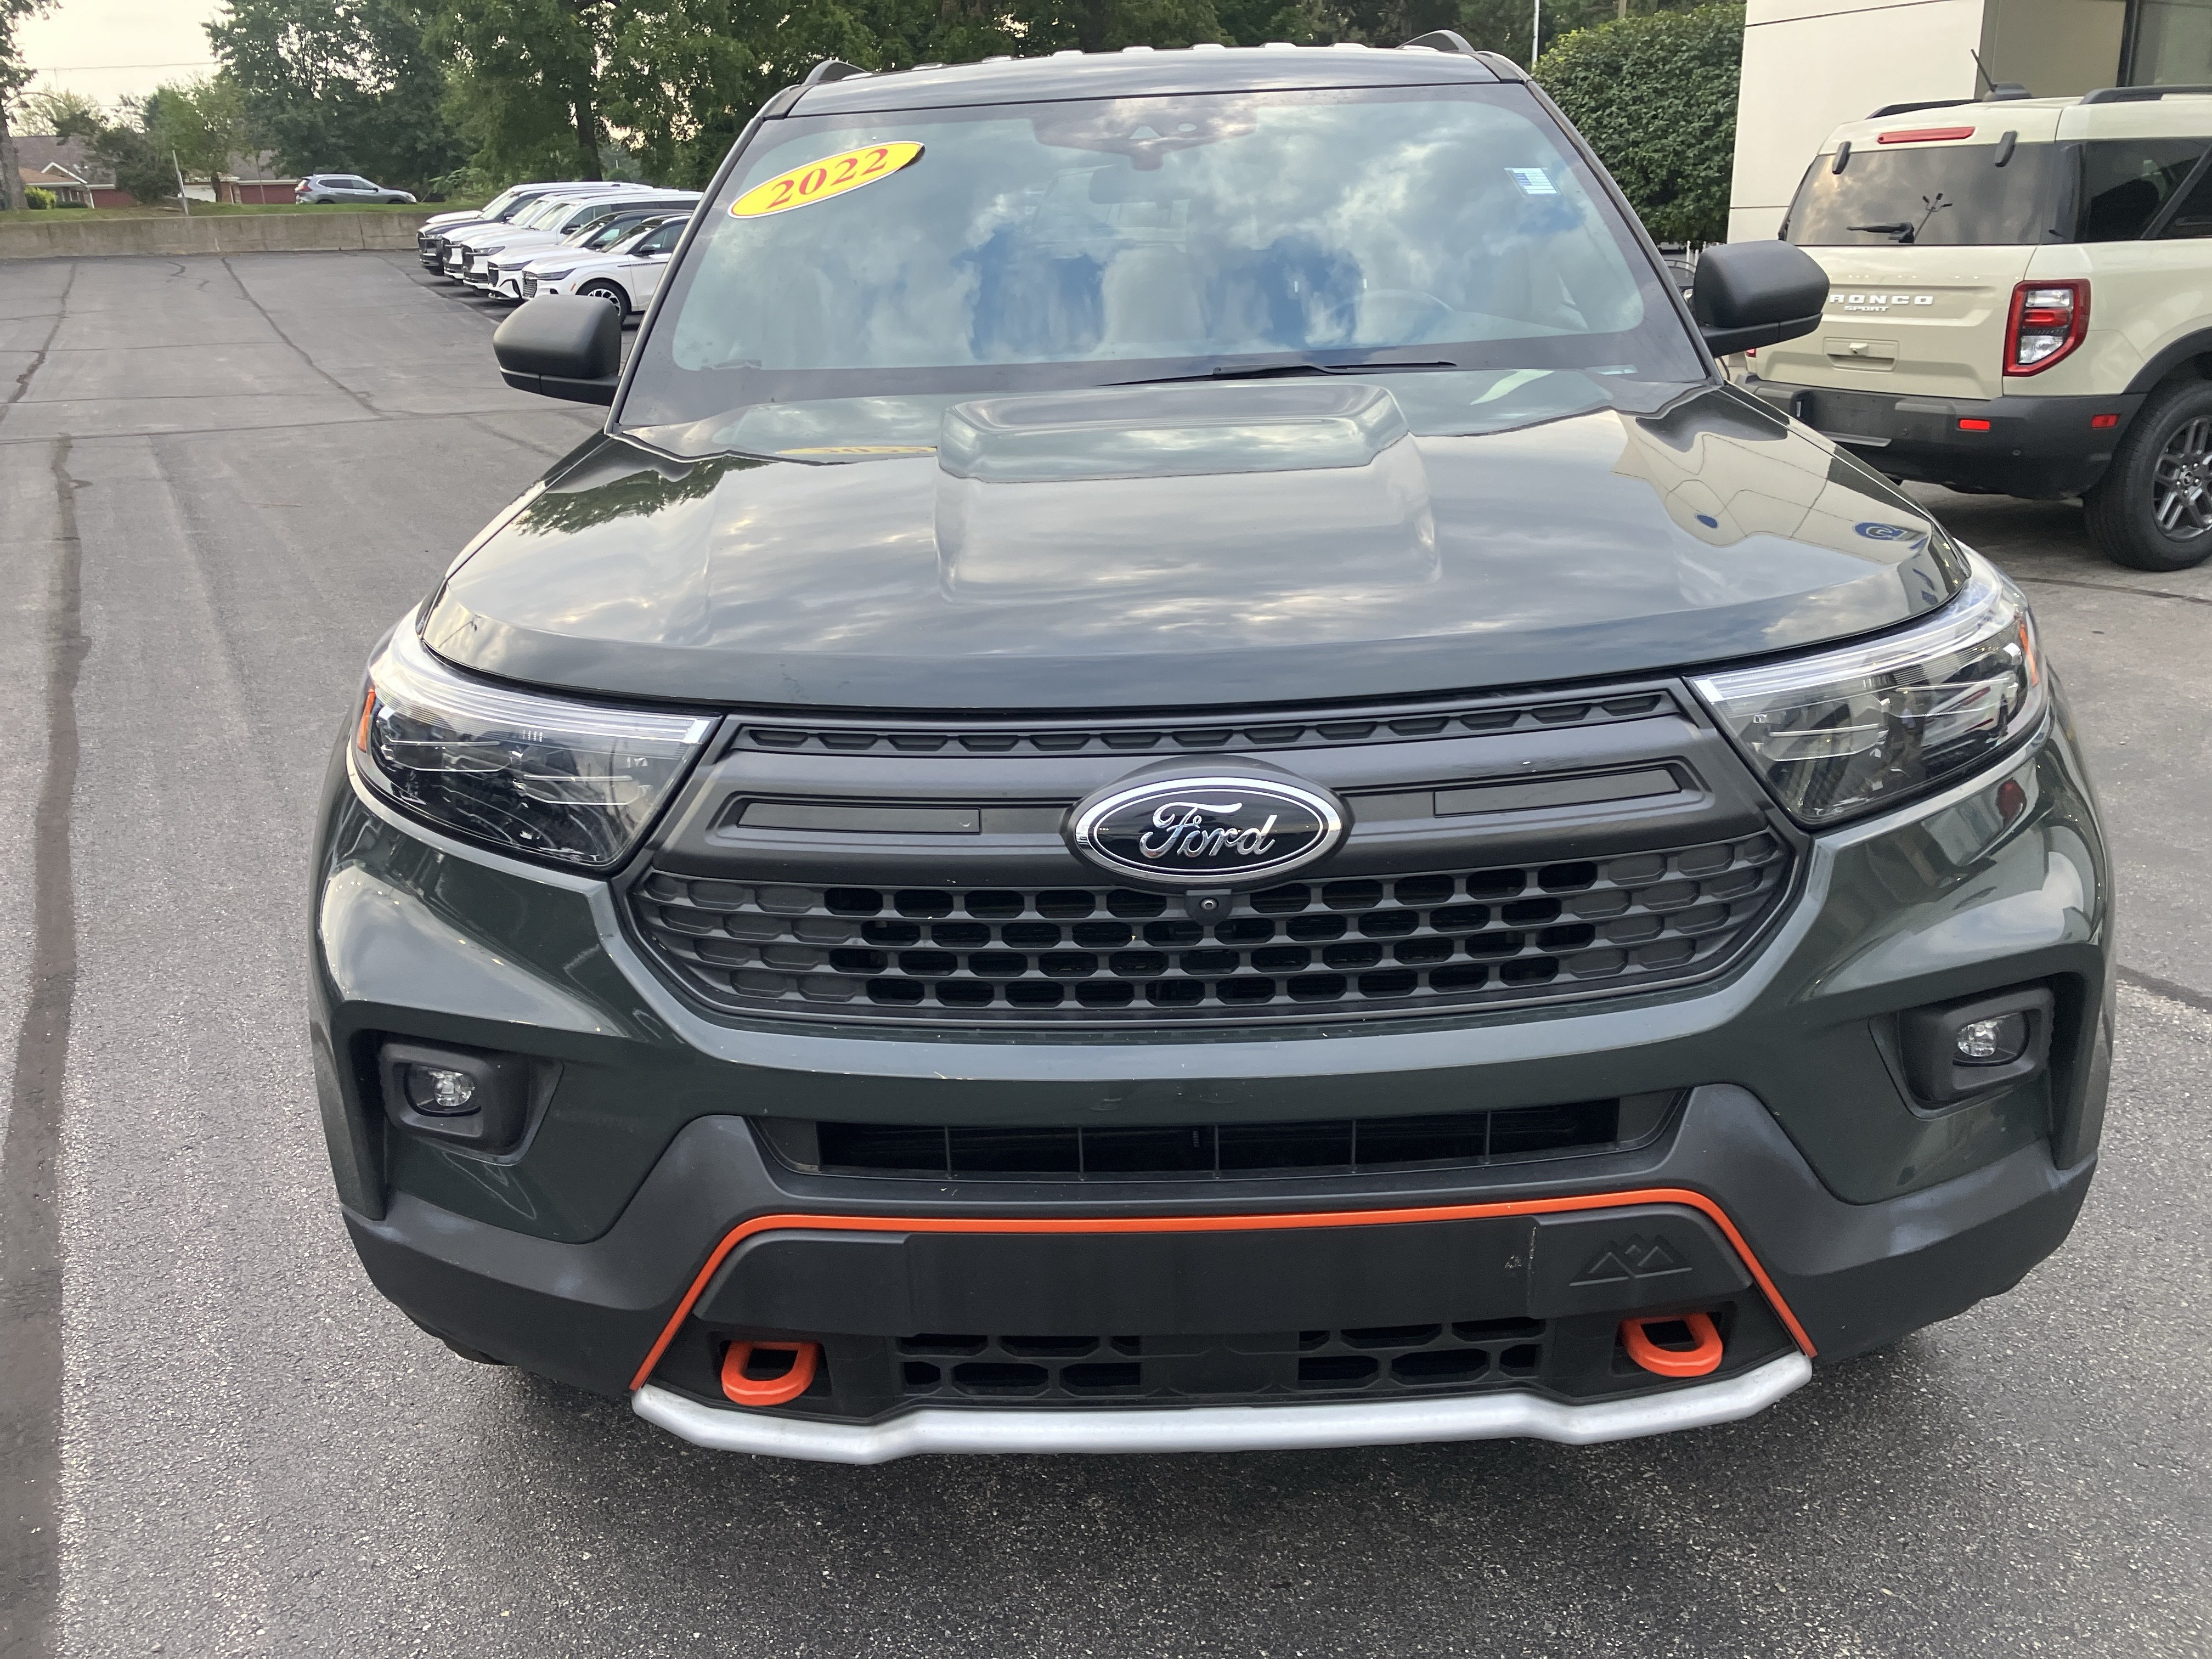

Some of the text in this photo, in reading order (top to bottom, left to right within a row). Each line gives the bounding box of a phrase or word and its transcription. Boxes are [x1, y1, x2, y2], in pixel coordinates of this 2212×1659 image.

[766, 148, 888, 210] 2022
[1829, 294, 1933, 305] RONCO
[1139, 802, 1278, 859] Ford
